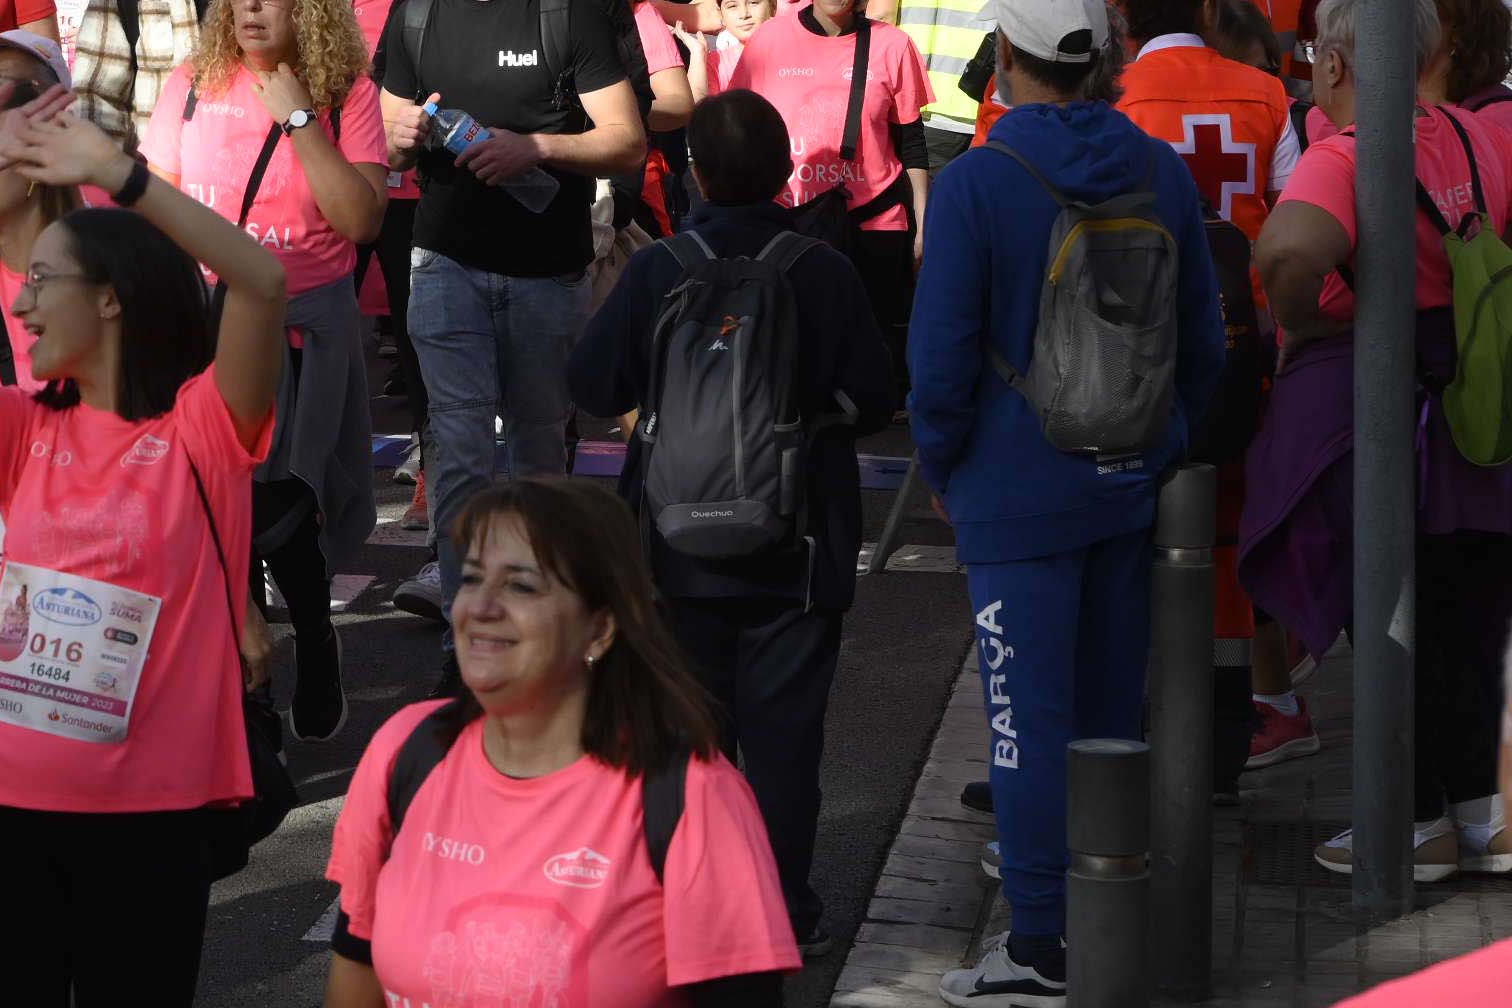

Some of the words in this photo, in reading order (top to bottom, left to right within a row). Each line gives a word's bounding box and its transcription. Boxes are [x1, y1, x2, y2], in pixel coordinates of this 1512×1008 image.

[498, 48, 538, 68] Huel
[789, 135, 804, 156] U
[245, 222, 294, 250] SAL
[690, 510, 734, 519] Quechua
[36, 597, 98, 621] ASTURIANA
[29, 632, 85, 663] 016
[29, 662, 72, 683] 16484
[28, 682, 41, 693] DE
[42, 685, 54, 696] LA
[55, 688, 89, 704] MUJER
[975, 599, 1020, 769] BARÇA
[61, 713, 113, 734] Santander
[425, 831, 486, 865] YSHO
